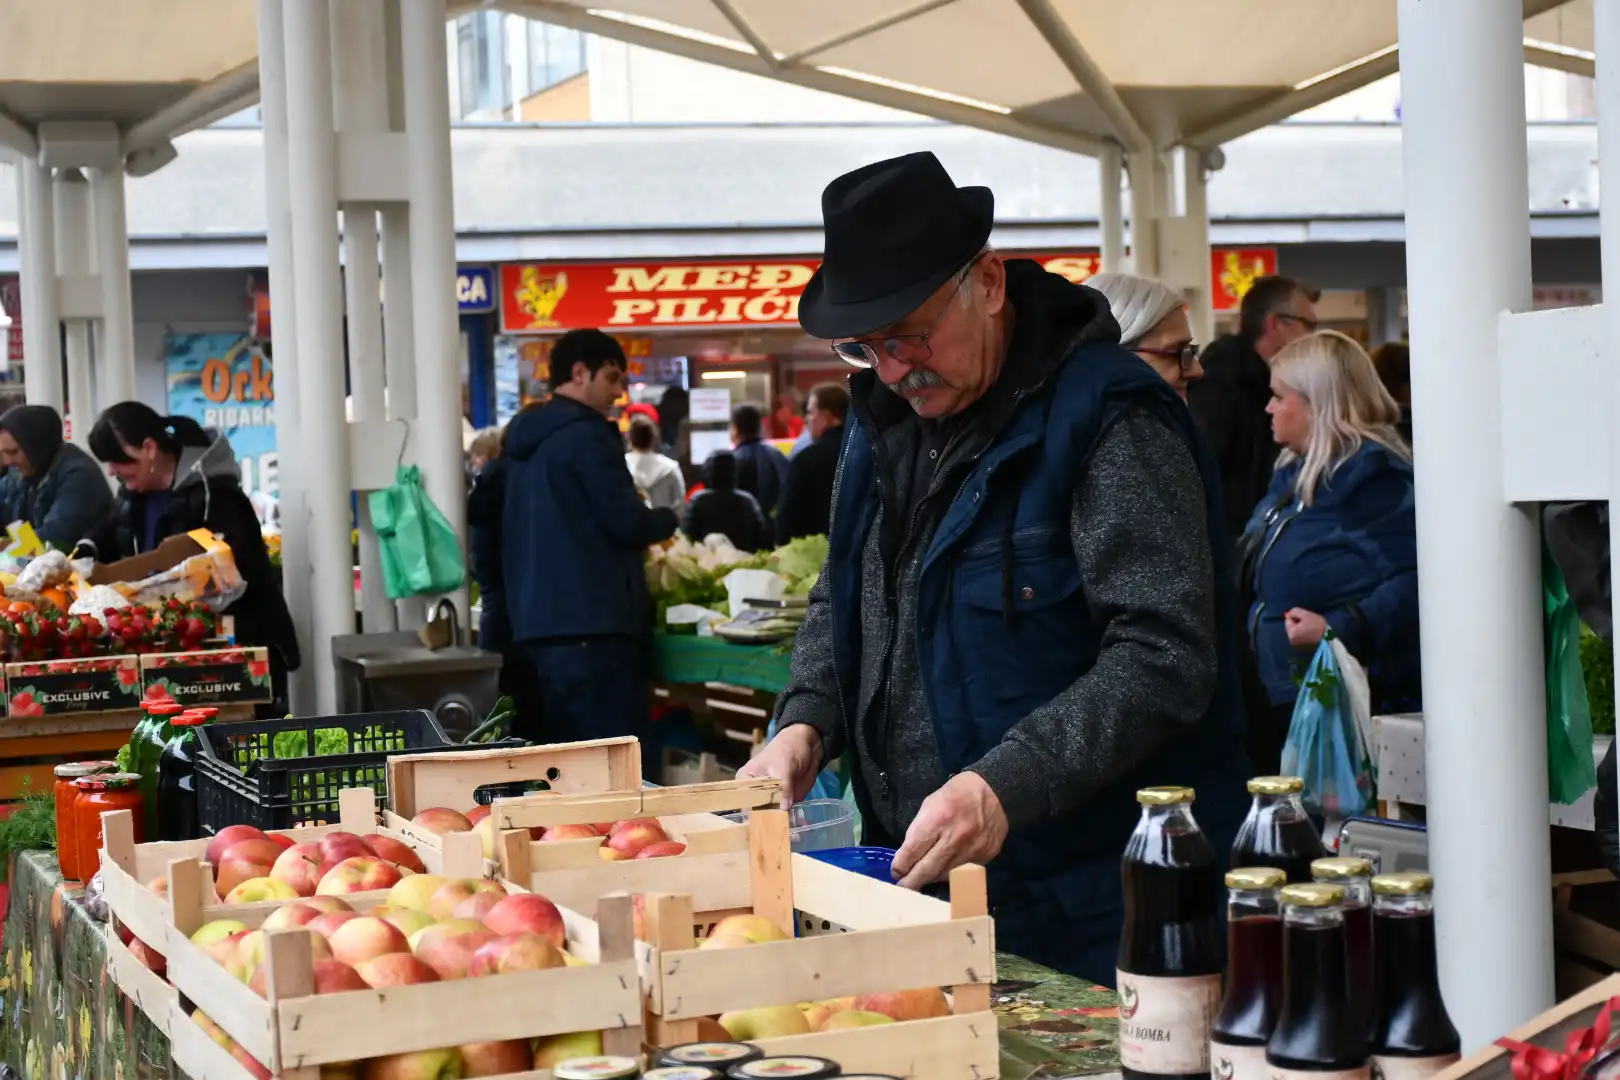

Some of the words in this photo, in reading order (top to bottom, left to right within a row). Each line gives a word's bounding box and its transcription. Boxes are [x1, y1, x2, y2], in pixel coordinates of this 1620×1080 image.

[174, 682, 242, 695] EXCLUSIVE
[42, 690, 111, 704] EXCLUSIVE
[1135, 1027, 1171, 1042] BOMBA
